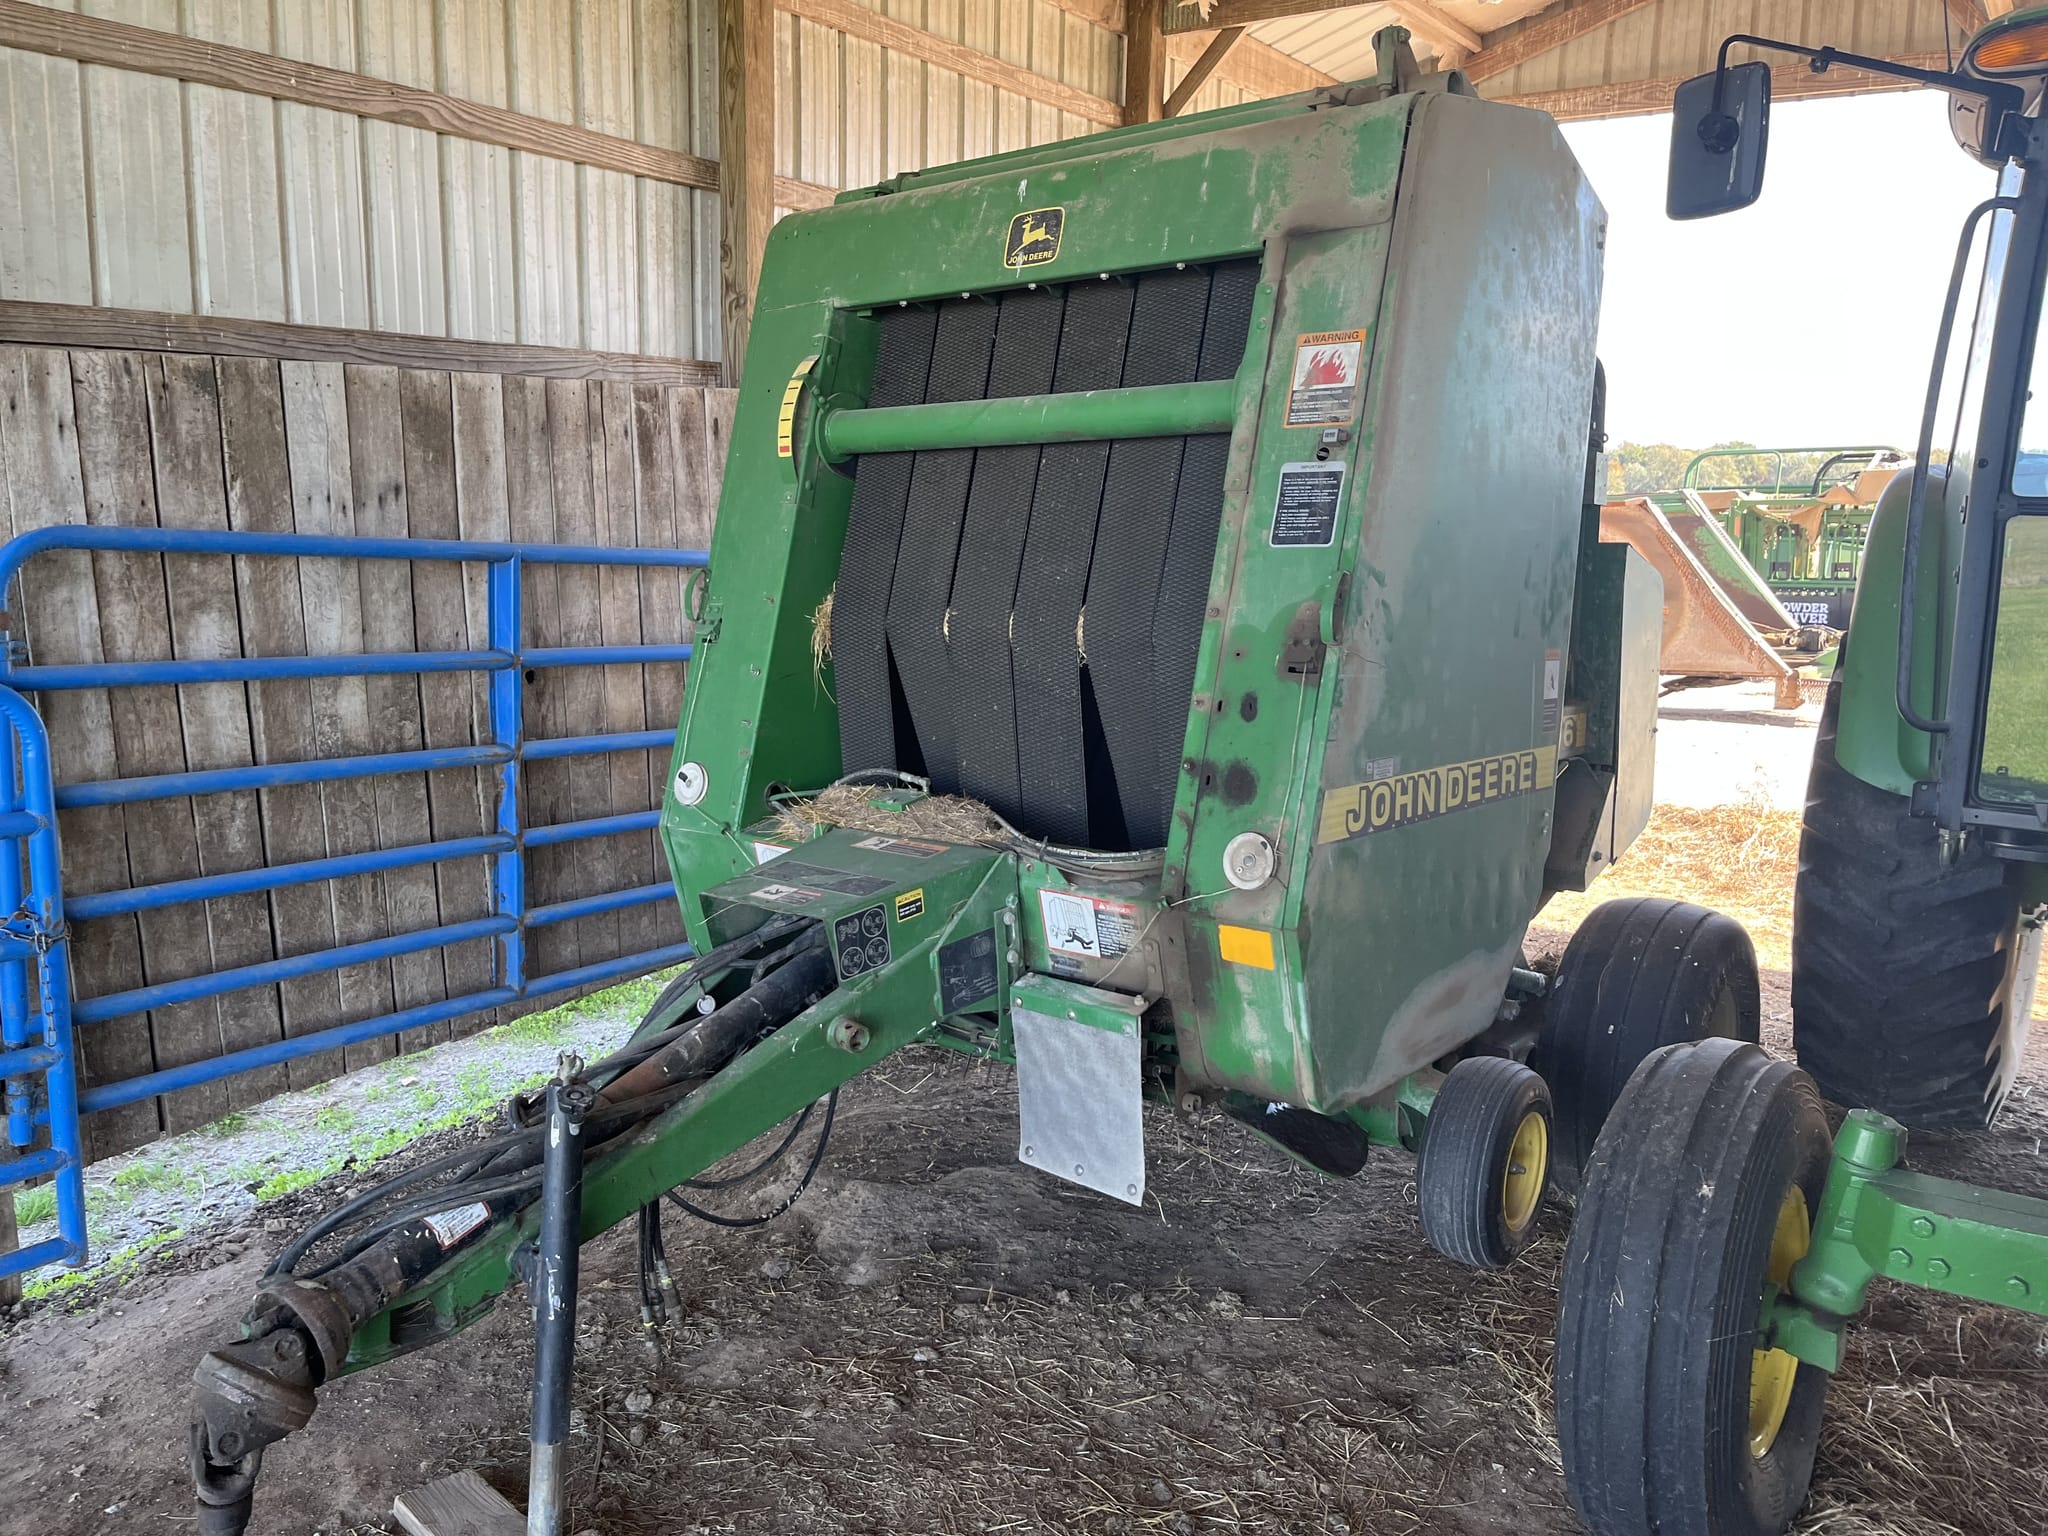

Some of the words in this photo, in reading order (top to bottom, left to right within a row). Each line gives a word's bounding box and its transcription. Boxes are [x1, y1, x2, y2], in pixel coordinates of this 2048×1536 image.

[1008, 254, 1028, 265] JOHN
[1029, 250, 1053, 261] DEERE
[1311, 331, 1359, 343] WARNING
[1782, 602, 1829, 613] OWDER
[1346, 770, 1441, 835] JOHN
[1446, 751, 1538, 809] DEERE
